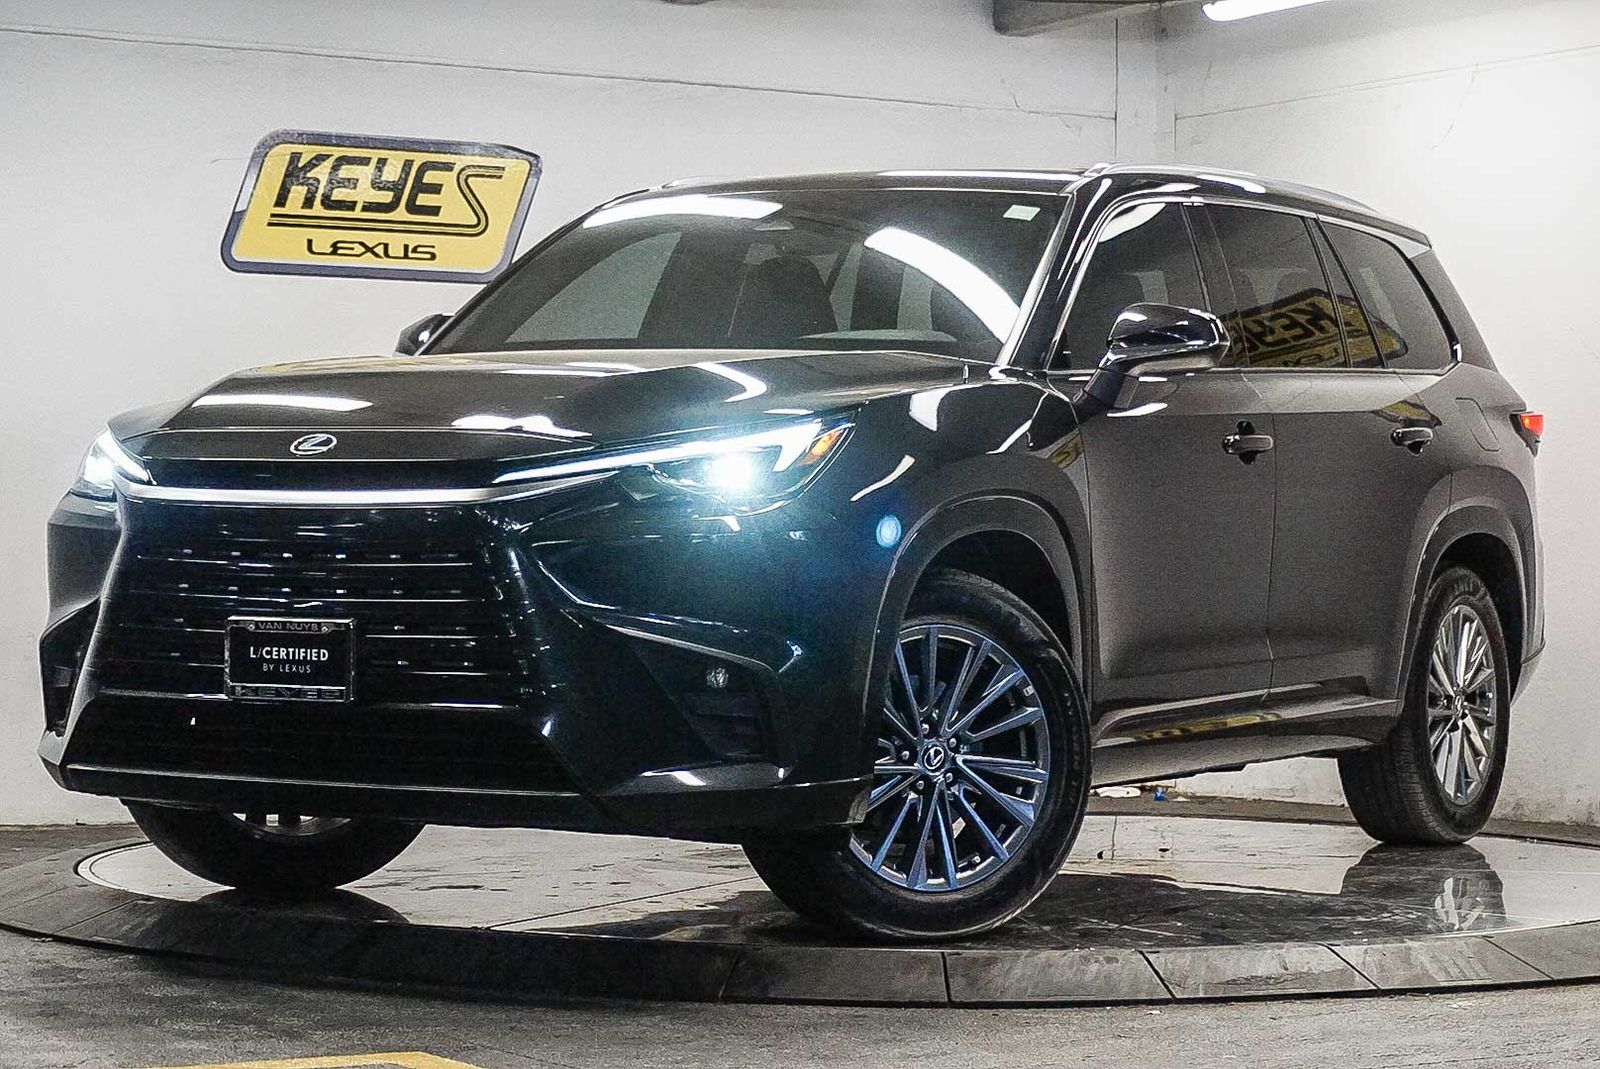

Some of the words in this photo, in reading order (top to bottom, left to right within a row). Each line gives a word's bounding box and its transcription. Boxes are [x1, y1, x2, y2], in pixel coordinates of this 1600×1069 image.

[268, 151, 506, 236] KEYES
[306, 238, 437, 262] LEXUS
[257, 621, 283, 630] VAN
[286, 622, 319, 631] NUYS
[249, 646, 329, 661] L/CERTIFIED
[262, 663, 275, 672] BY
[279, 663, 311, 674] LEXUS
